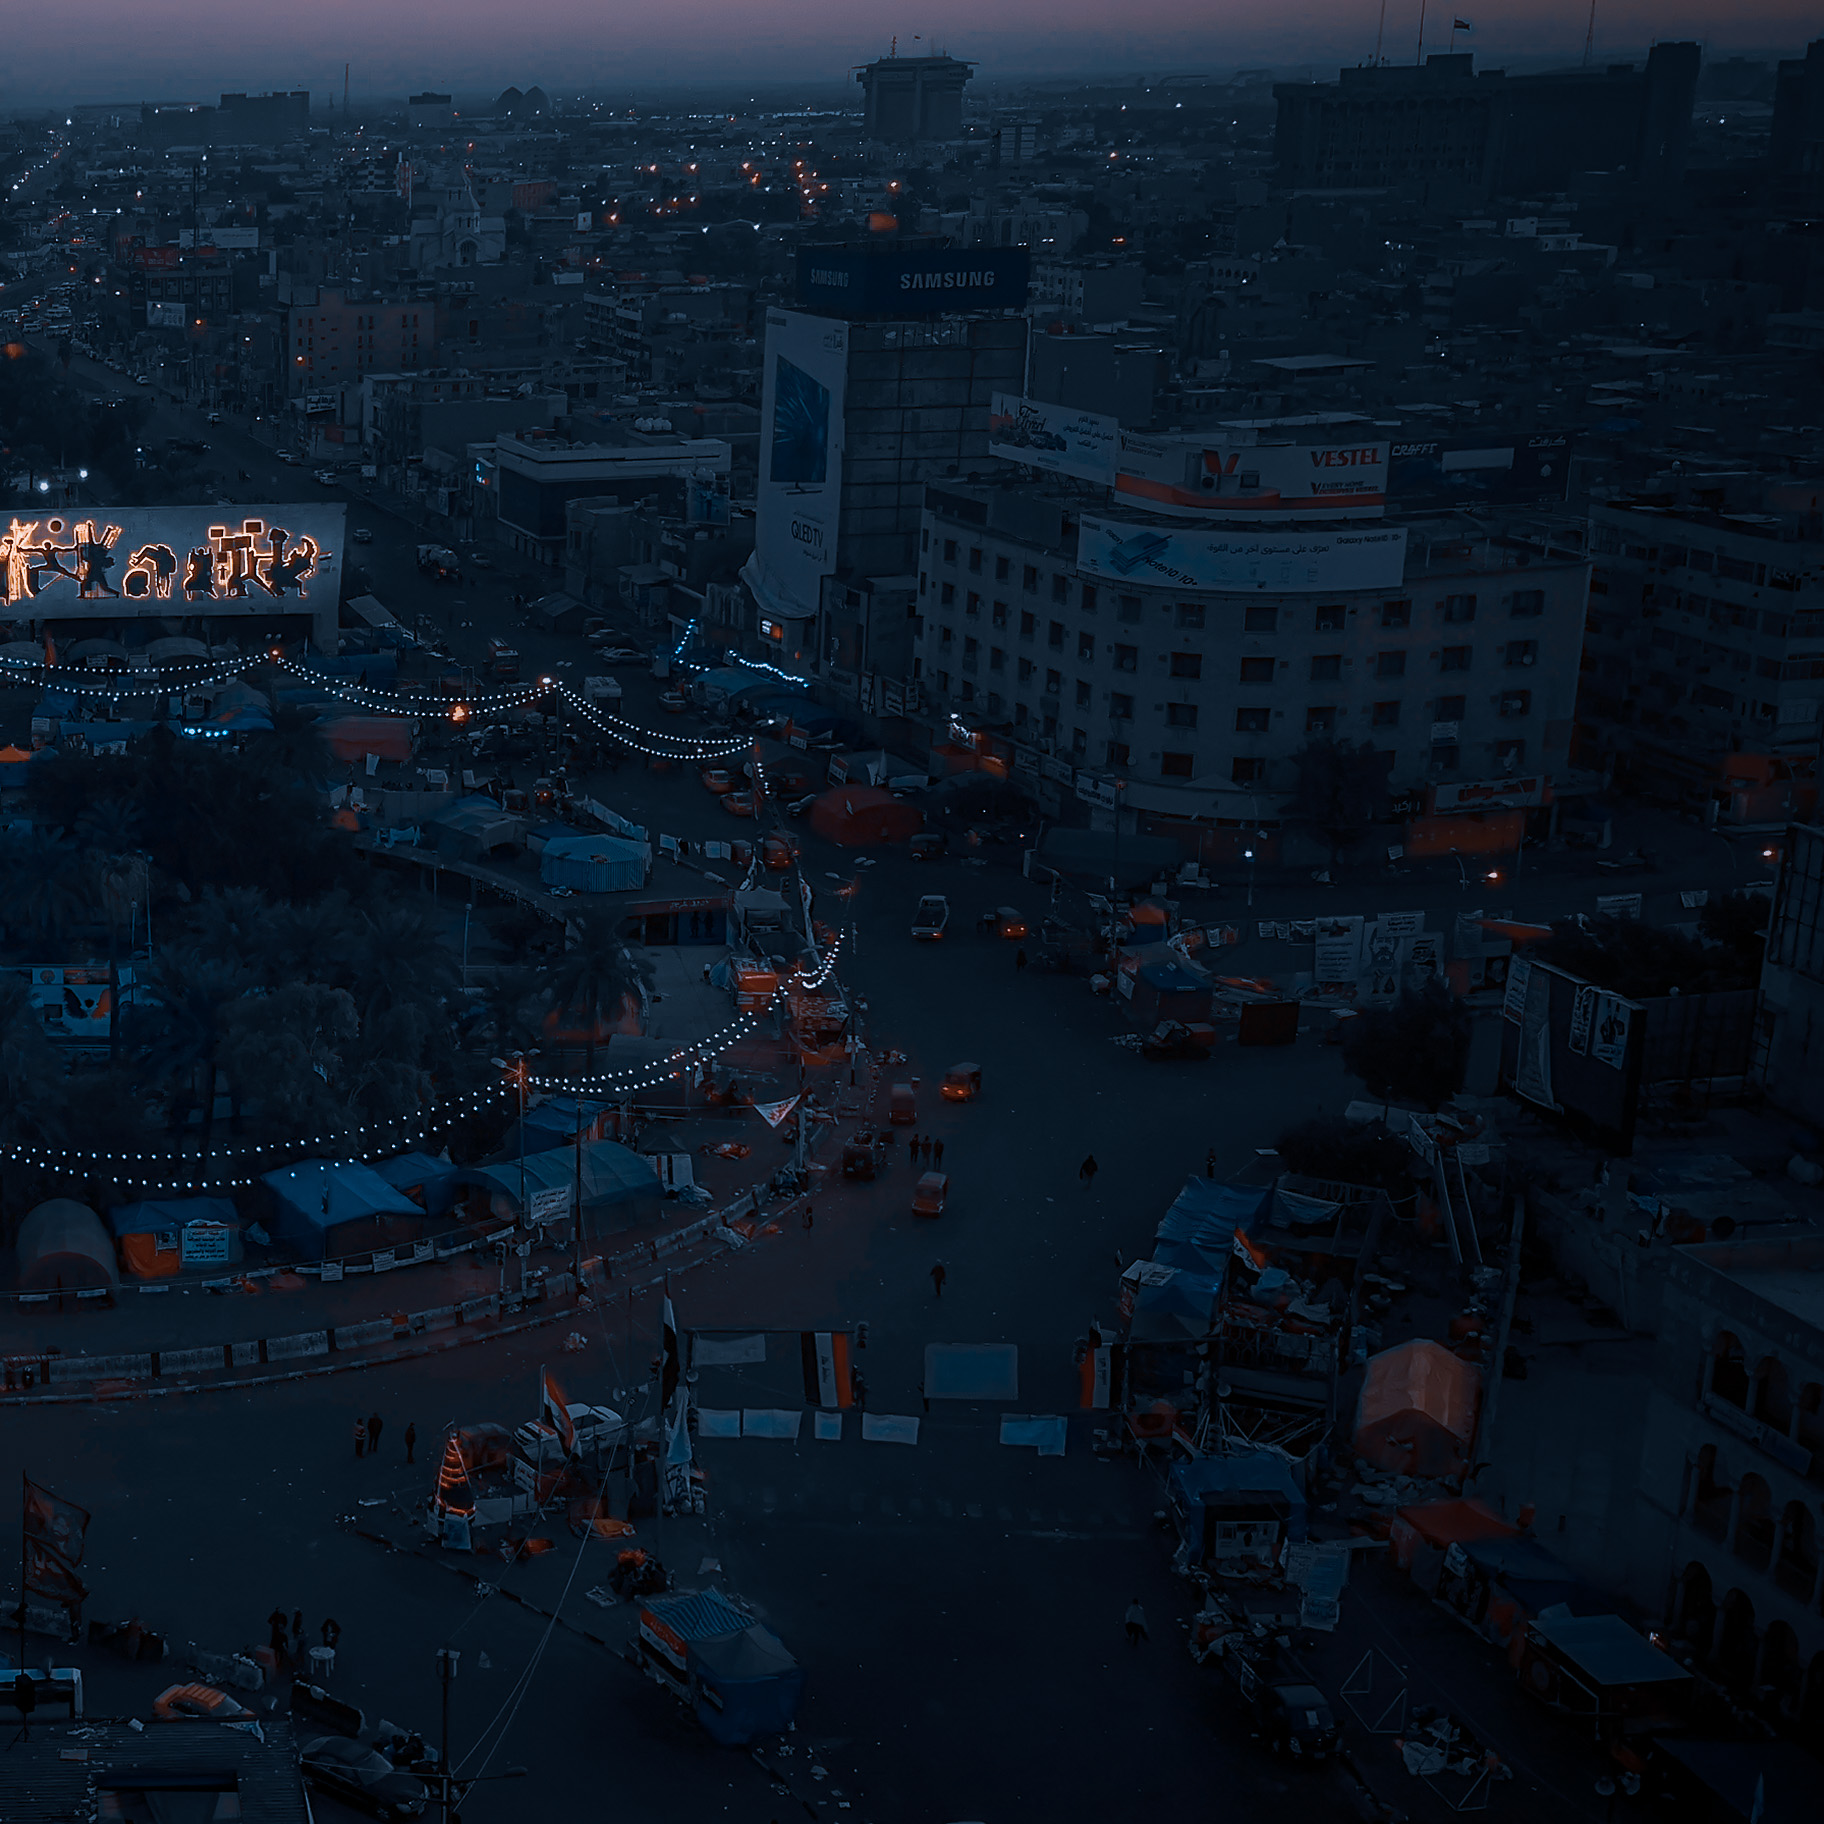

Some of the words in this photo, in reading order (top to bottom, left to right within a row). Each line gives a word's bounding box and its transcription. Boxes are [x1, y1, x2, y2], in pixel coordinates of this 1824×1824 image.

[810, 268, 849, 288] SAMSUNG
[900, 270, 995, 289] SAMSUNG
[1311, 447, 1382, 467] VESTEL
[791, 520, 813, 544] QLED
[1336, 535, 1363, 545] Galaxy
[1229, 545, 1243, 554] من
[1292, 544, 1307, 554] على
